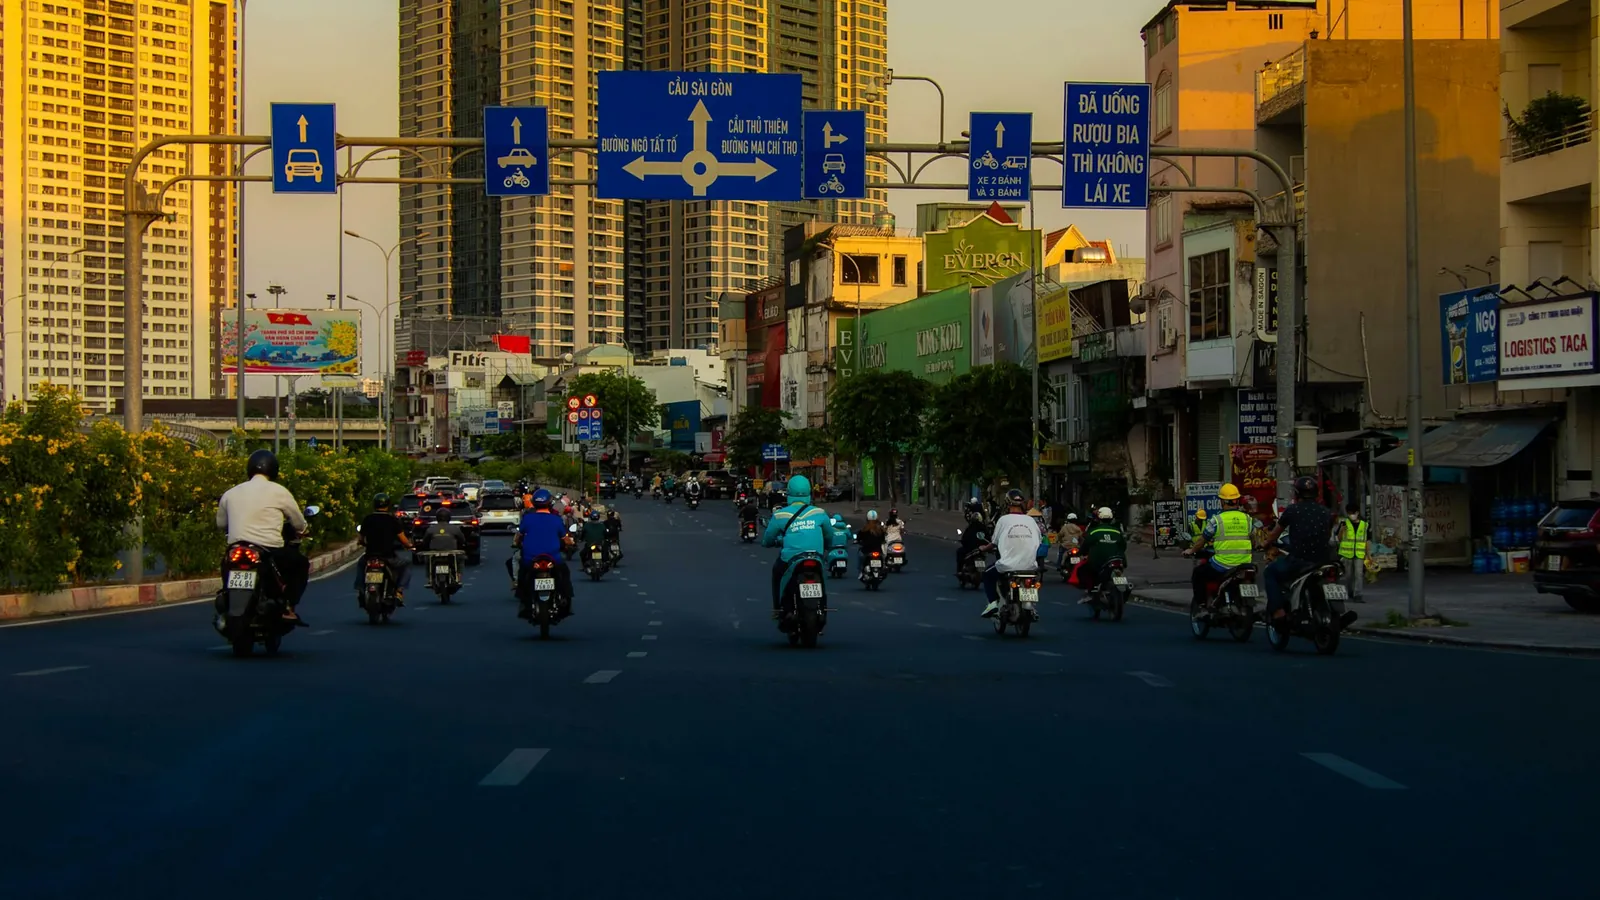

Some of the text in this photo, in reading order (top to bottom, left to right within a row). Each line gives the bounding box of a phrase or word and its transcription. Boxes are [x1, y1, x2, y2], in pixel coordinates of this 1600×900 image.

[668, 76, 732, 96] CẦU SÀI GÒN
[1078, 88, 1140, 114] ĐÃ UỐNG
[728, 114, 788, 134] CẦU THỦ THIÊM
[602, 134, 678, 152] ĐƯỜNG NGÔ TẤT TỐ
[1072, 122, 1140, 147] RƯỢU BIA
[722, 136, 798, 157] ĐƯỜNG MAI CHÍ THỌ
[1072, 149, 1144, 174] THÌ KHÔNG
[978, 174, 1022, 185] XE 2 BÁNH
[976, 186, 1022, 196] VÀ 3 BÁNH
[1084, 178, 1130, 203] LÁI XE
[944, 252, 1024, 270] EVERON
[764, 305, 779, 320] auto
[916, 328, 939, 356] KING
[940, 321, 962, 352] KOIL
[1504, 333, 1588, 358] LOGISTICS TACA
